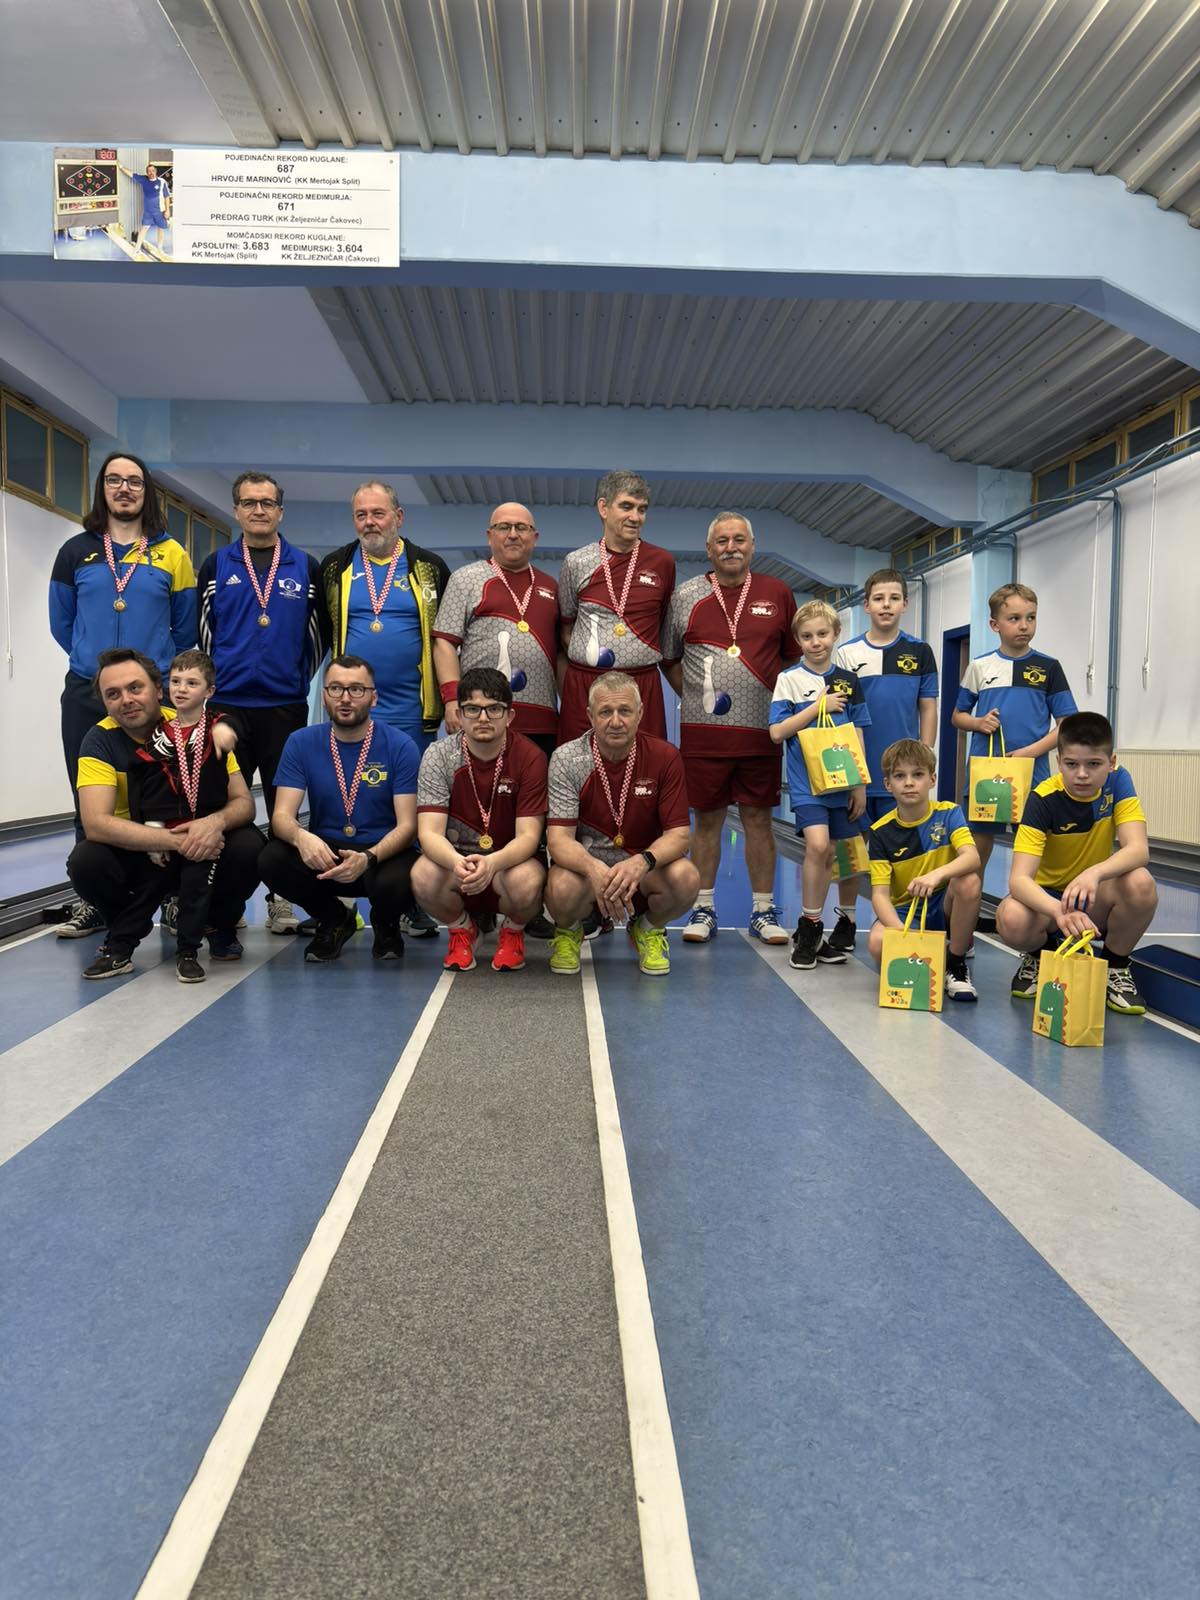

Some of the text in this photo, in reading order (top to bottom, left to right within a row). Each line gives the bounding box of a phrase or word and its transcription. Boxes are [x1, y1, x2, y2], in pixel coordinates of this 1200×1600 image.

[225, 153, 349, 164] POJEDINAČNI REKORD KUGLANE:
[277, 164, 295, 173] 687
[211, 175, 244, 183] HRVOJE
[294, 177, 308, 186] (KK
[309, 177, 338, 187] Mertojak
[338, 178, 361, 187] Split)
[219, 191, 270, 200] POJEDINAČNI
[271, 192, 304, 200] REKORD
[277, 202, 295, 211] 671
[210, 213, 250, 222] PREDRAG
[252, 214, 274, 222] TURK
[275, 216, 289, 224] (KK
[226, 231, 346, 242] MOMČADSKI REKORD KUGLANE:
[191, 242, 270, 251] APSOLUTNI: 3.683
[336, 244, 363, 253] 3.604
[204, 251, 236, 260] Mertojak
[236, 252, 258, 261] (Split)
[281, 253, 291, 261] KK
